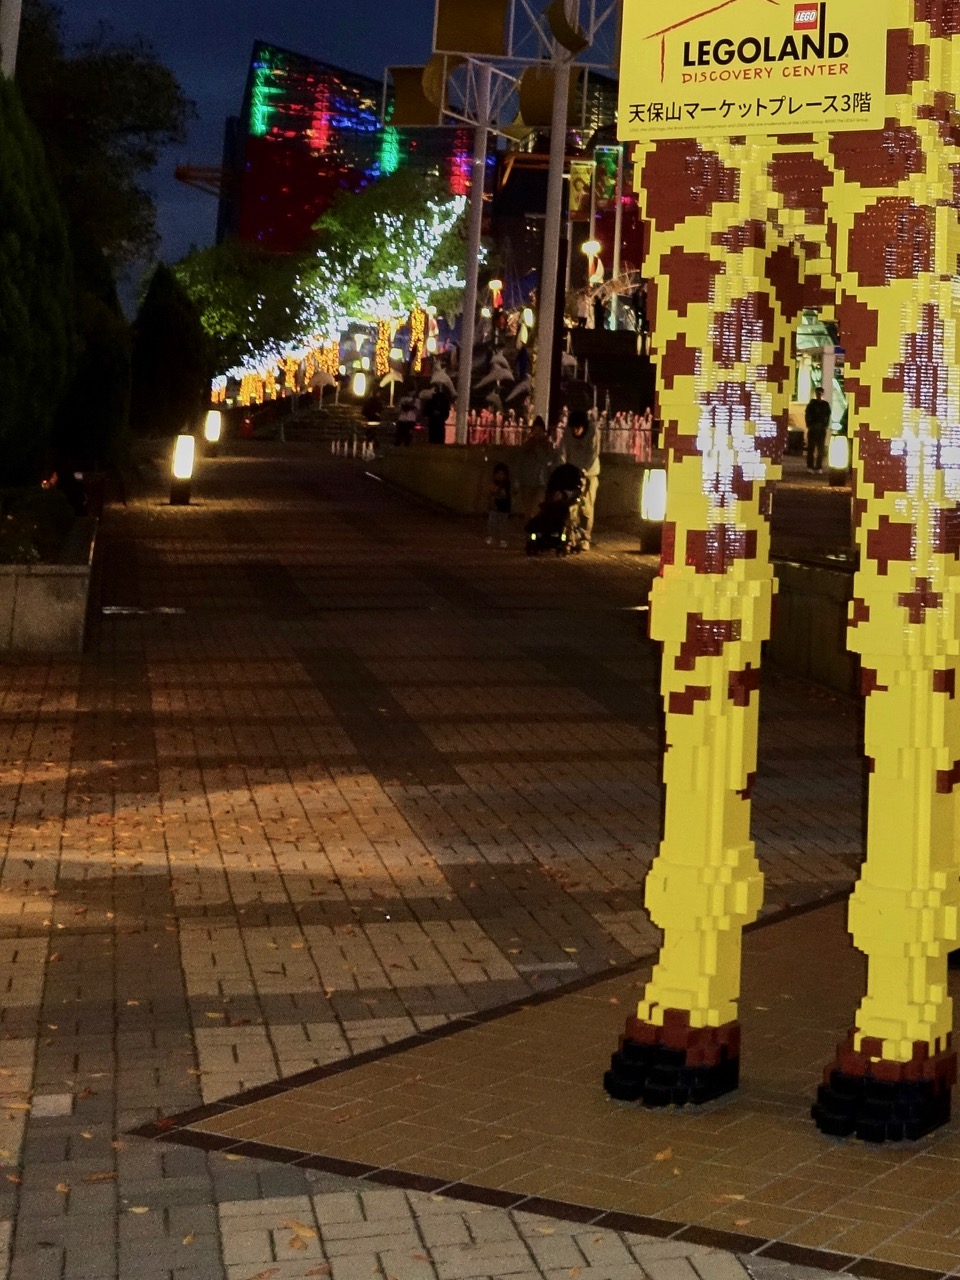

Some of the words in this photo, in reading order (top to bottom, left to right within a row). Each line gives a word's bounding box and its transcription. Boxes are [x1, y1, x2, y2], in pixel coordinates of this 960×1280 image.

[795, 9, 817, 24] LEGO
[683, 2, 849, 67] LEGOLAND
[682, 67, 773, 84] DISCOVERY
[782, 63, 849, 78] CENTER
[628, 91, 872, 123] 天保山マーケットプレース3階
